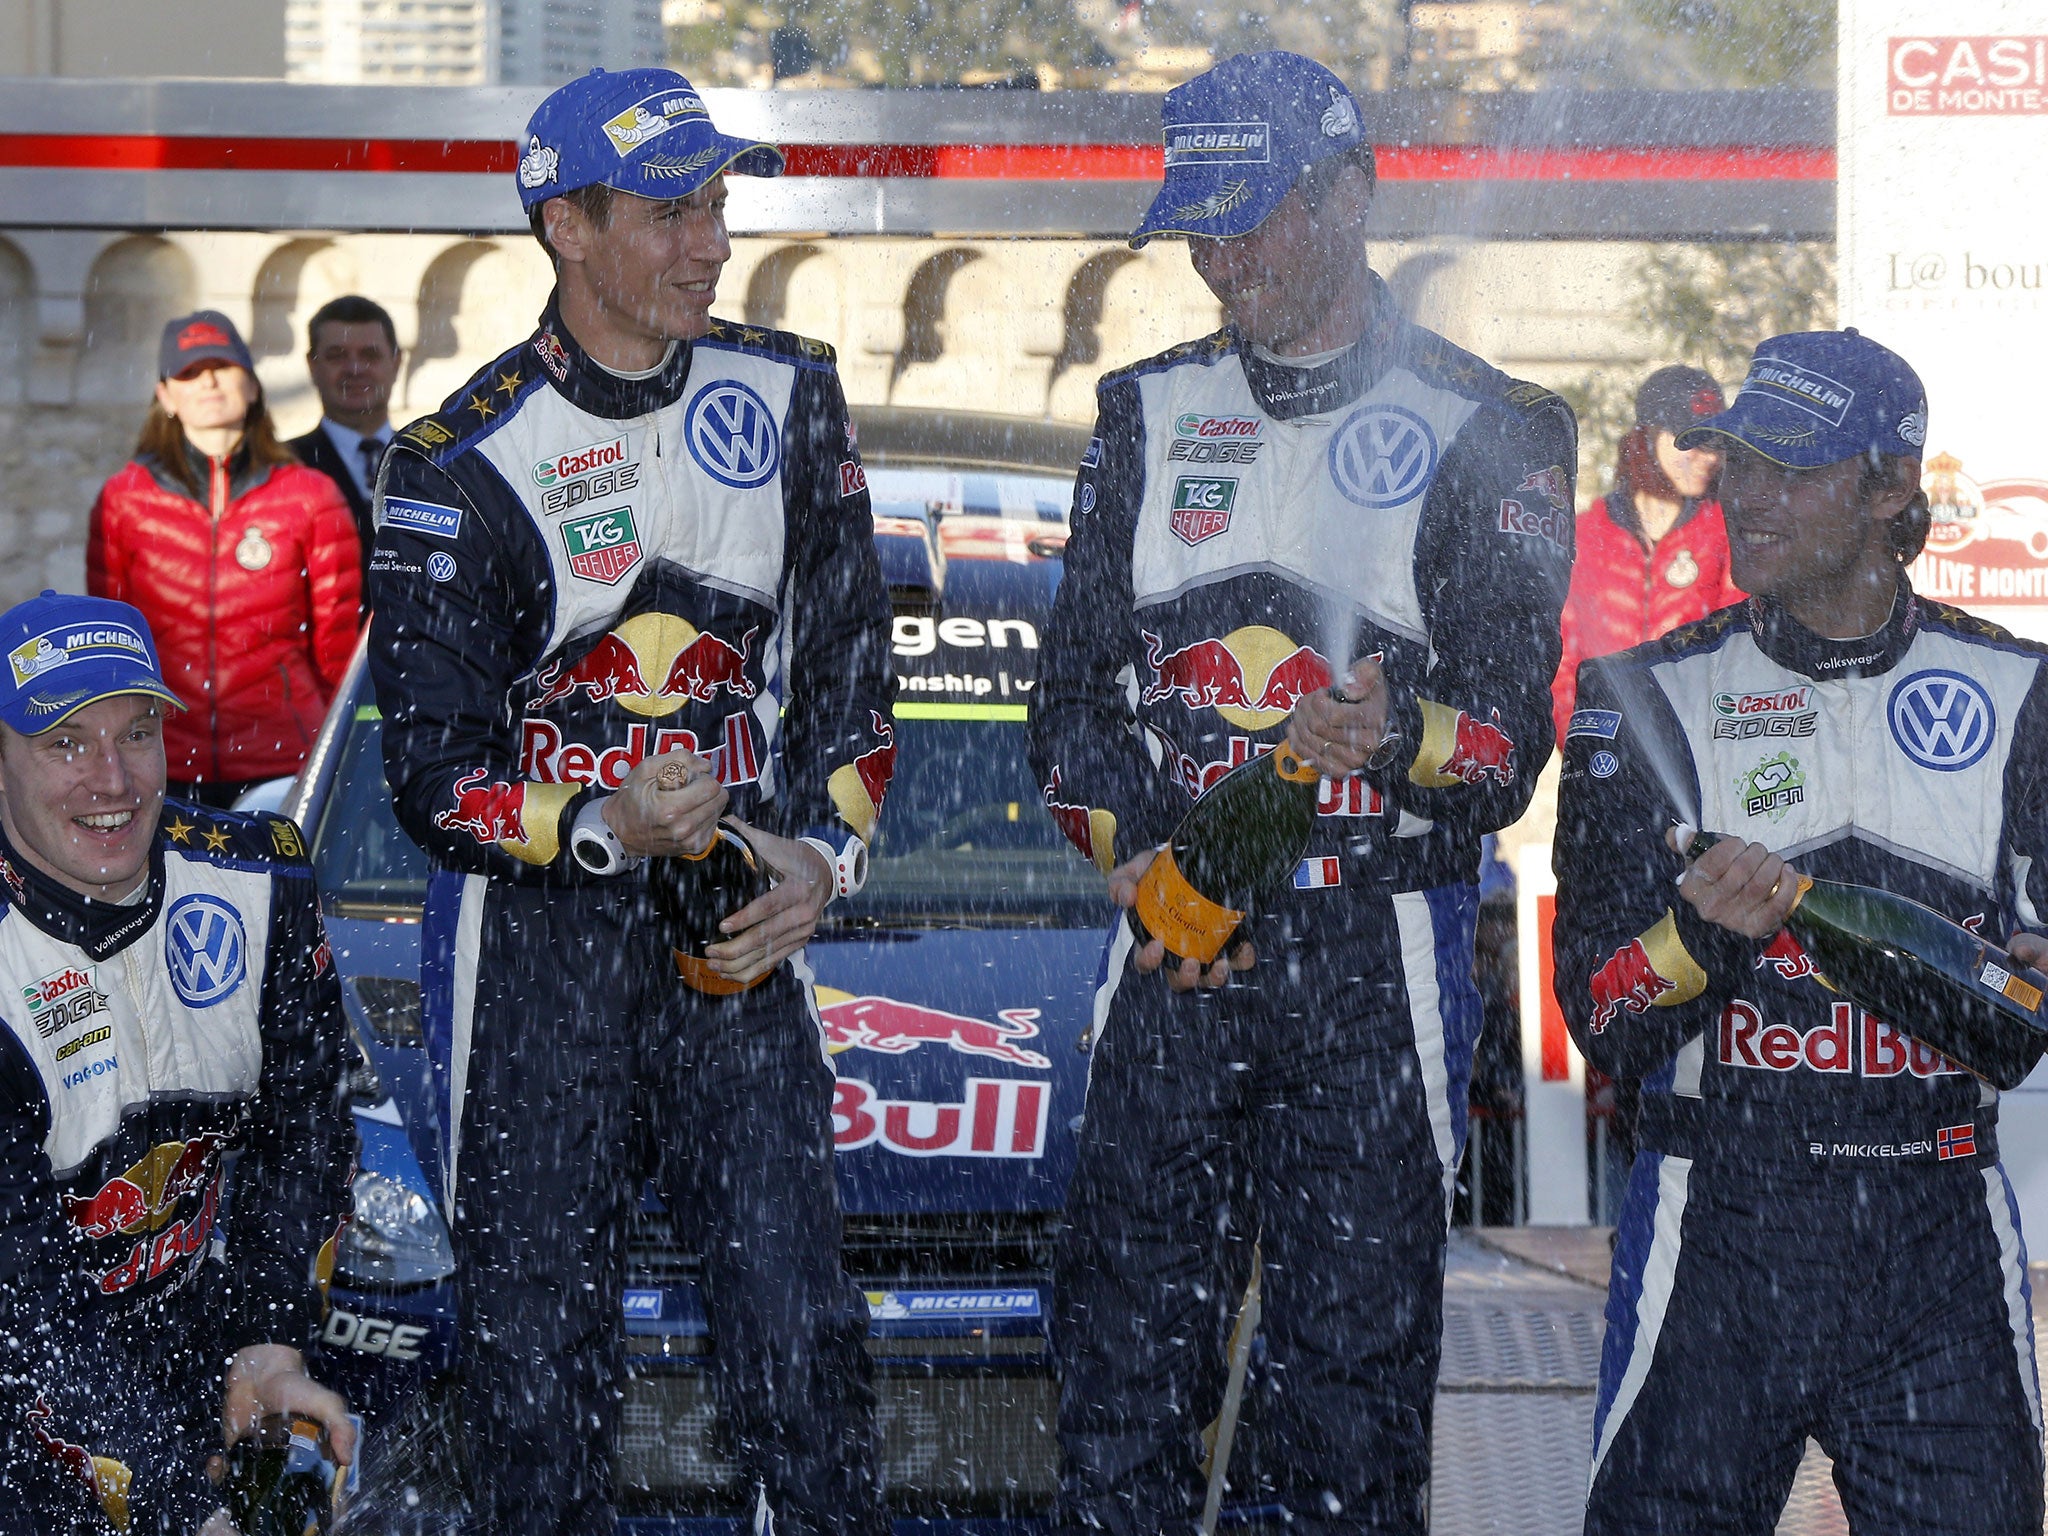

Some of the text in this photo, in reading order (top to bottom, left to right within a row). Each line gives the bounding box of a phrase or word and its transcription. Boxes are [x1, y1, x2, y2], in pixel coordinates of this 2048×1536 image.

[1892, 89, 1933, 111] DE
[1174, 133, 1265, 150] MICHELIN
[1265, 378, 1339, 405] Volkswagen
[1757, 366, 1847, 409] MICHELIN
[1198, 417, 1262, 438] Castrol
[557, 440, 625, 479] Castrol
[1166, 438, 1266, 465] EDGE
[541, 462, 641, 517] EDGE
[1183, 481, 1225, 508] TAG
[389, 505, 457, 527] MICHELIN
[1172, 512, 1224, 540] HEUER
[573, 516, 624, 551] TAG
[576, 545, 637, 579] HEUER
[1814, 650, 1885, 672] Volkswagen
[1737, 688, 1806, 715] Castrol
[1713, 711, 1819, 741] EDGE
[519, 719, 649, 790] Red
[33, 990, 111, 1039] EDGE
[56, 1025, 112, 1062] can-am
[1718, 998, 1853, 1073] Red
[833, 1077, 1052, 1159] Bull
[1832, 1140, 1933, 1158] MIKKELSEN
[909, 1294, 1035, 1310] MICHELIN
